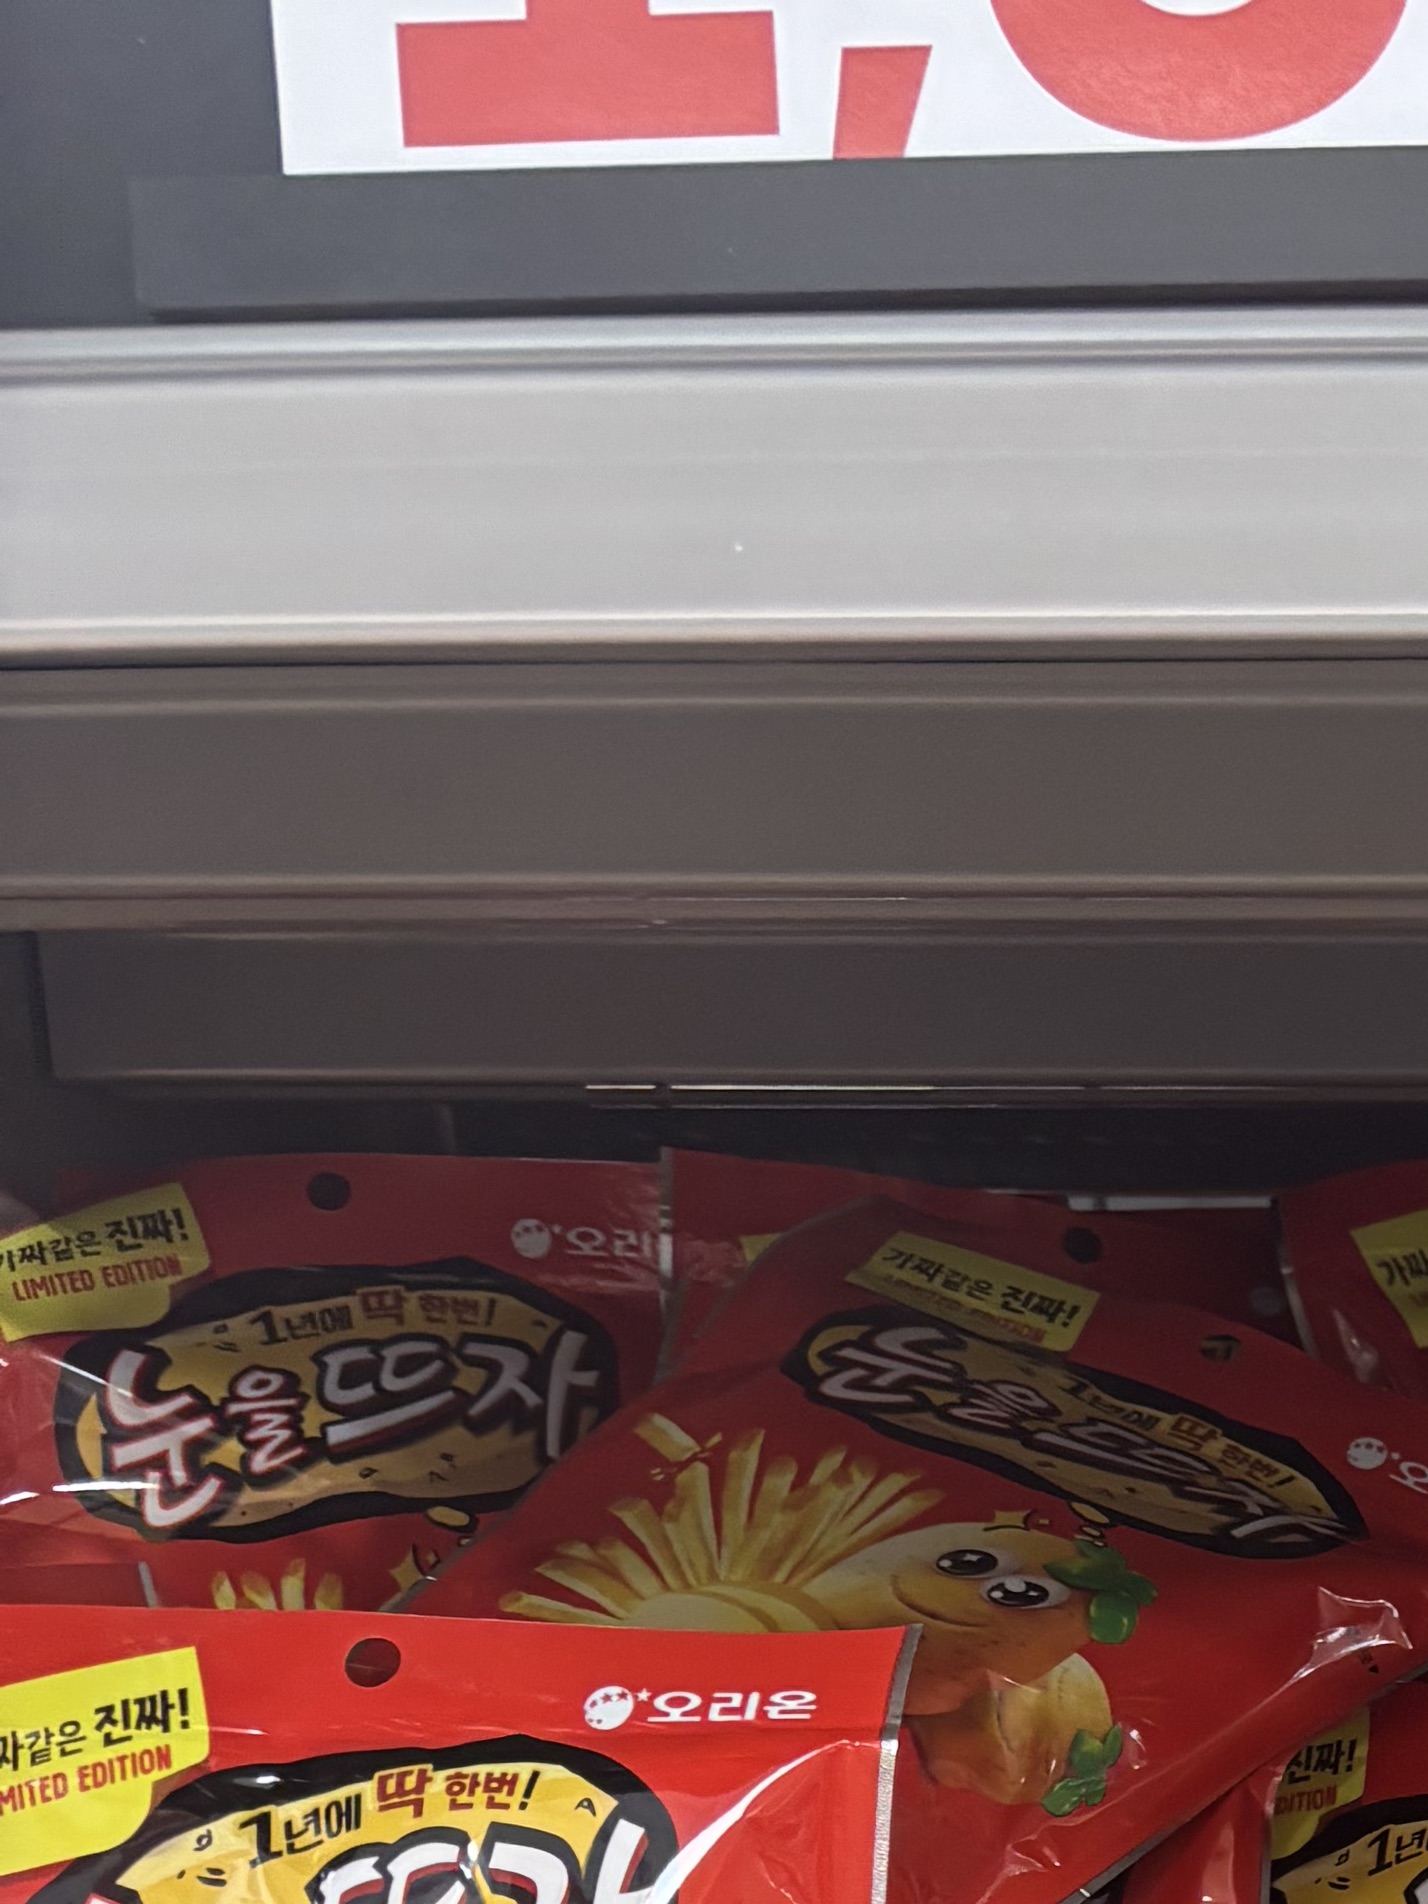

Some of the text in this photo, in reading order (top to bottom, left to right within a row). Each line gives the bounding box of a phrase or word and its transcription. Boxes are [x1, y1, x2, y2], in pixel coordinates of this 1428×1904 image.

[107, 1207, 189, 1254] 진짜!
[12, 1254, 182, 1302] LIMITED EDITION
[881, 1247, 994, 1301] 가짜같은
[999, 1280, 1083, 1329] 진짜!
[249, 1287, 497, 1347] 1년에 딱 한번!
[1170, 1414, 1219, 1452] 딱
[95, 1688, 191, 1750] 진짜!
[647, 1688, 818, 1723] 오리온
[78, 1745, 173, 1796] EDITION
[244, 1768, 540, 1862] 1년에 딱 한번!
